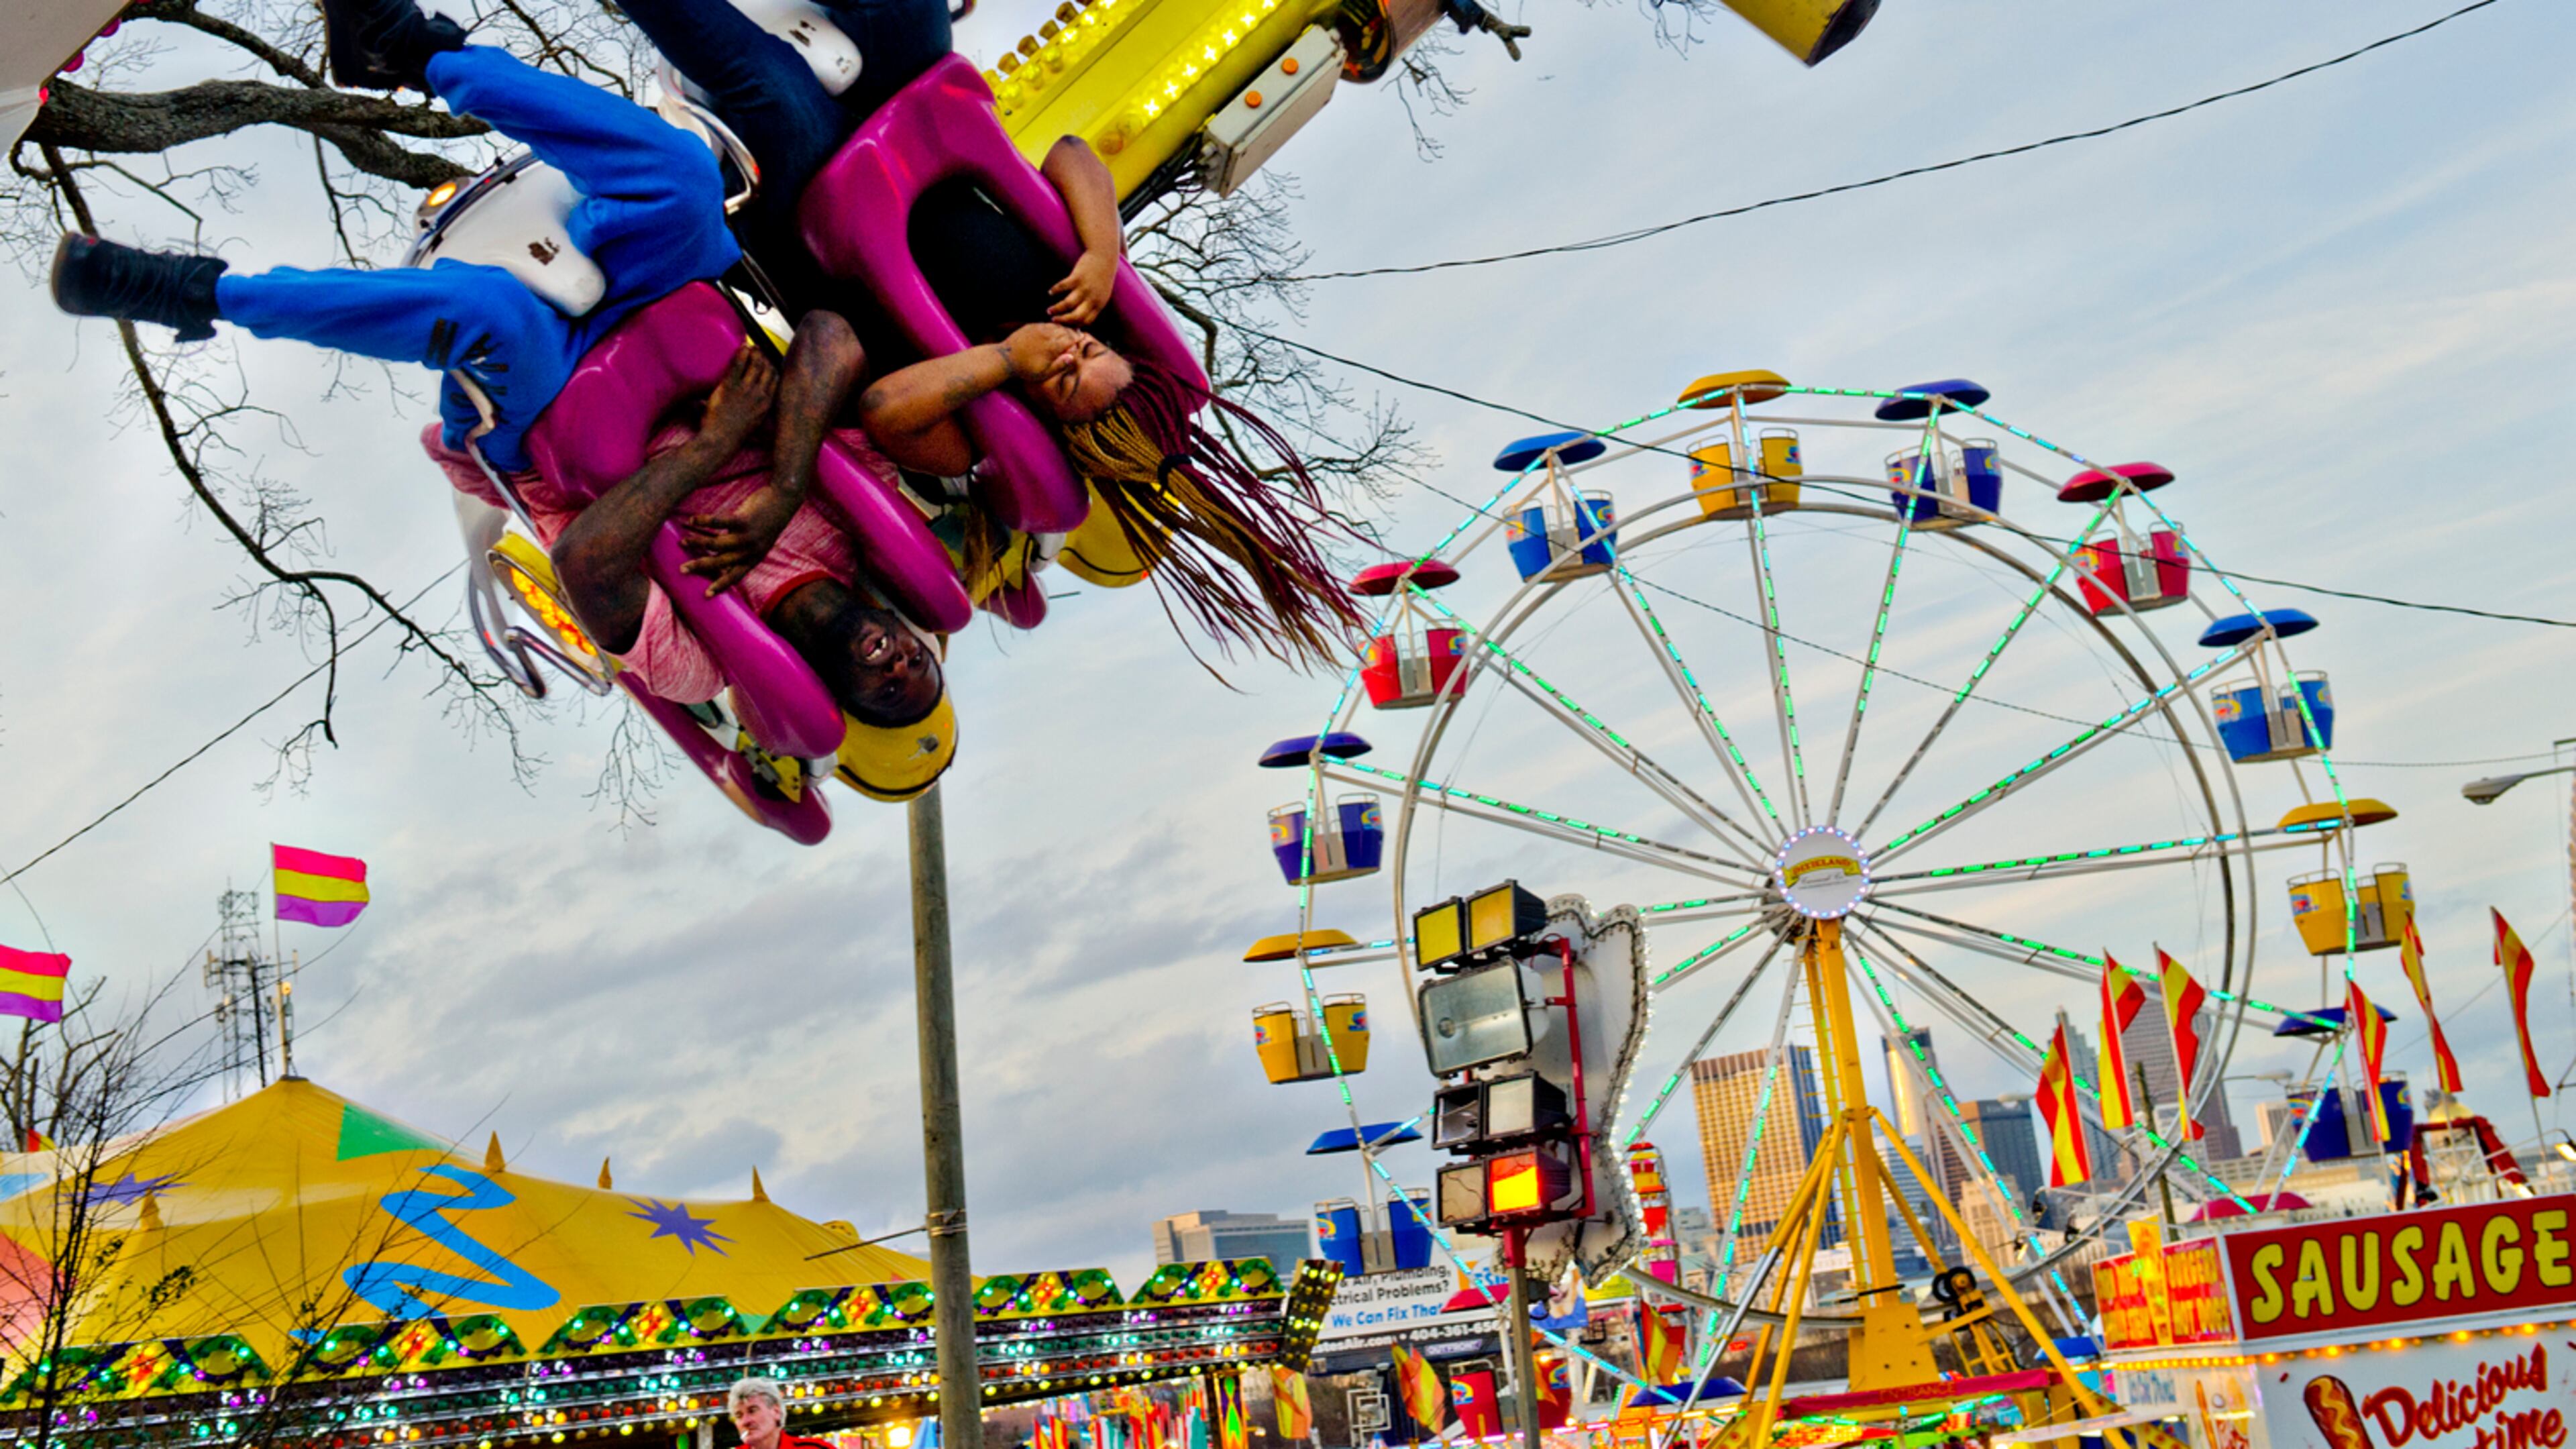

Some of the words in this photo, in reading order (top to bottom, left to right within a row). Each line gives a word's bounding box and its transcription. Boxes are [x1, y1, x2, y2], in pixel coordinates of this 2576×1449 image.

[2251, 1210, 2572, 1323] SAUSAGE
[1377, 1280, 1449, 1300] Problems?
[1332, 1314, 1352, 1328] We
[1356, 1311, 1383, 1325] Can
[1387, 1307, 1407, 1321] Fix
[1880, 1382, 1955, 1401] ENTRANCE
[2362, 1342, 2547, 1447] Delicious
